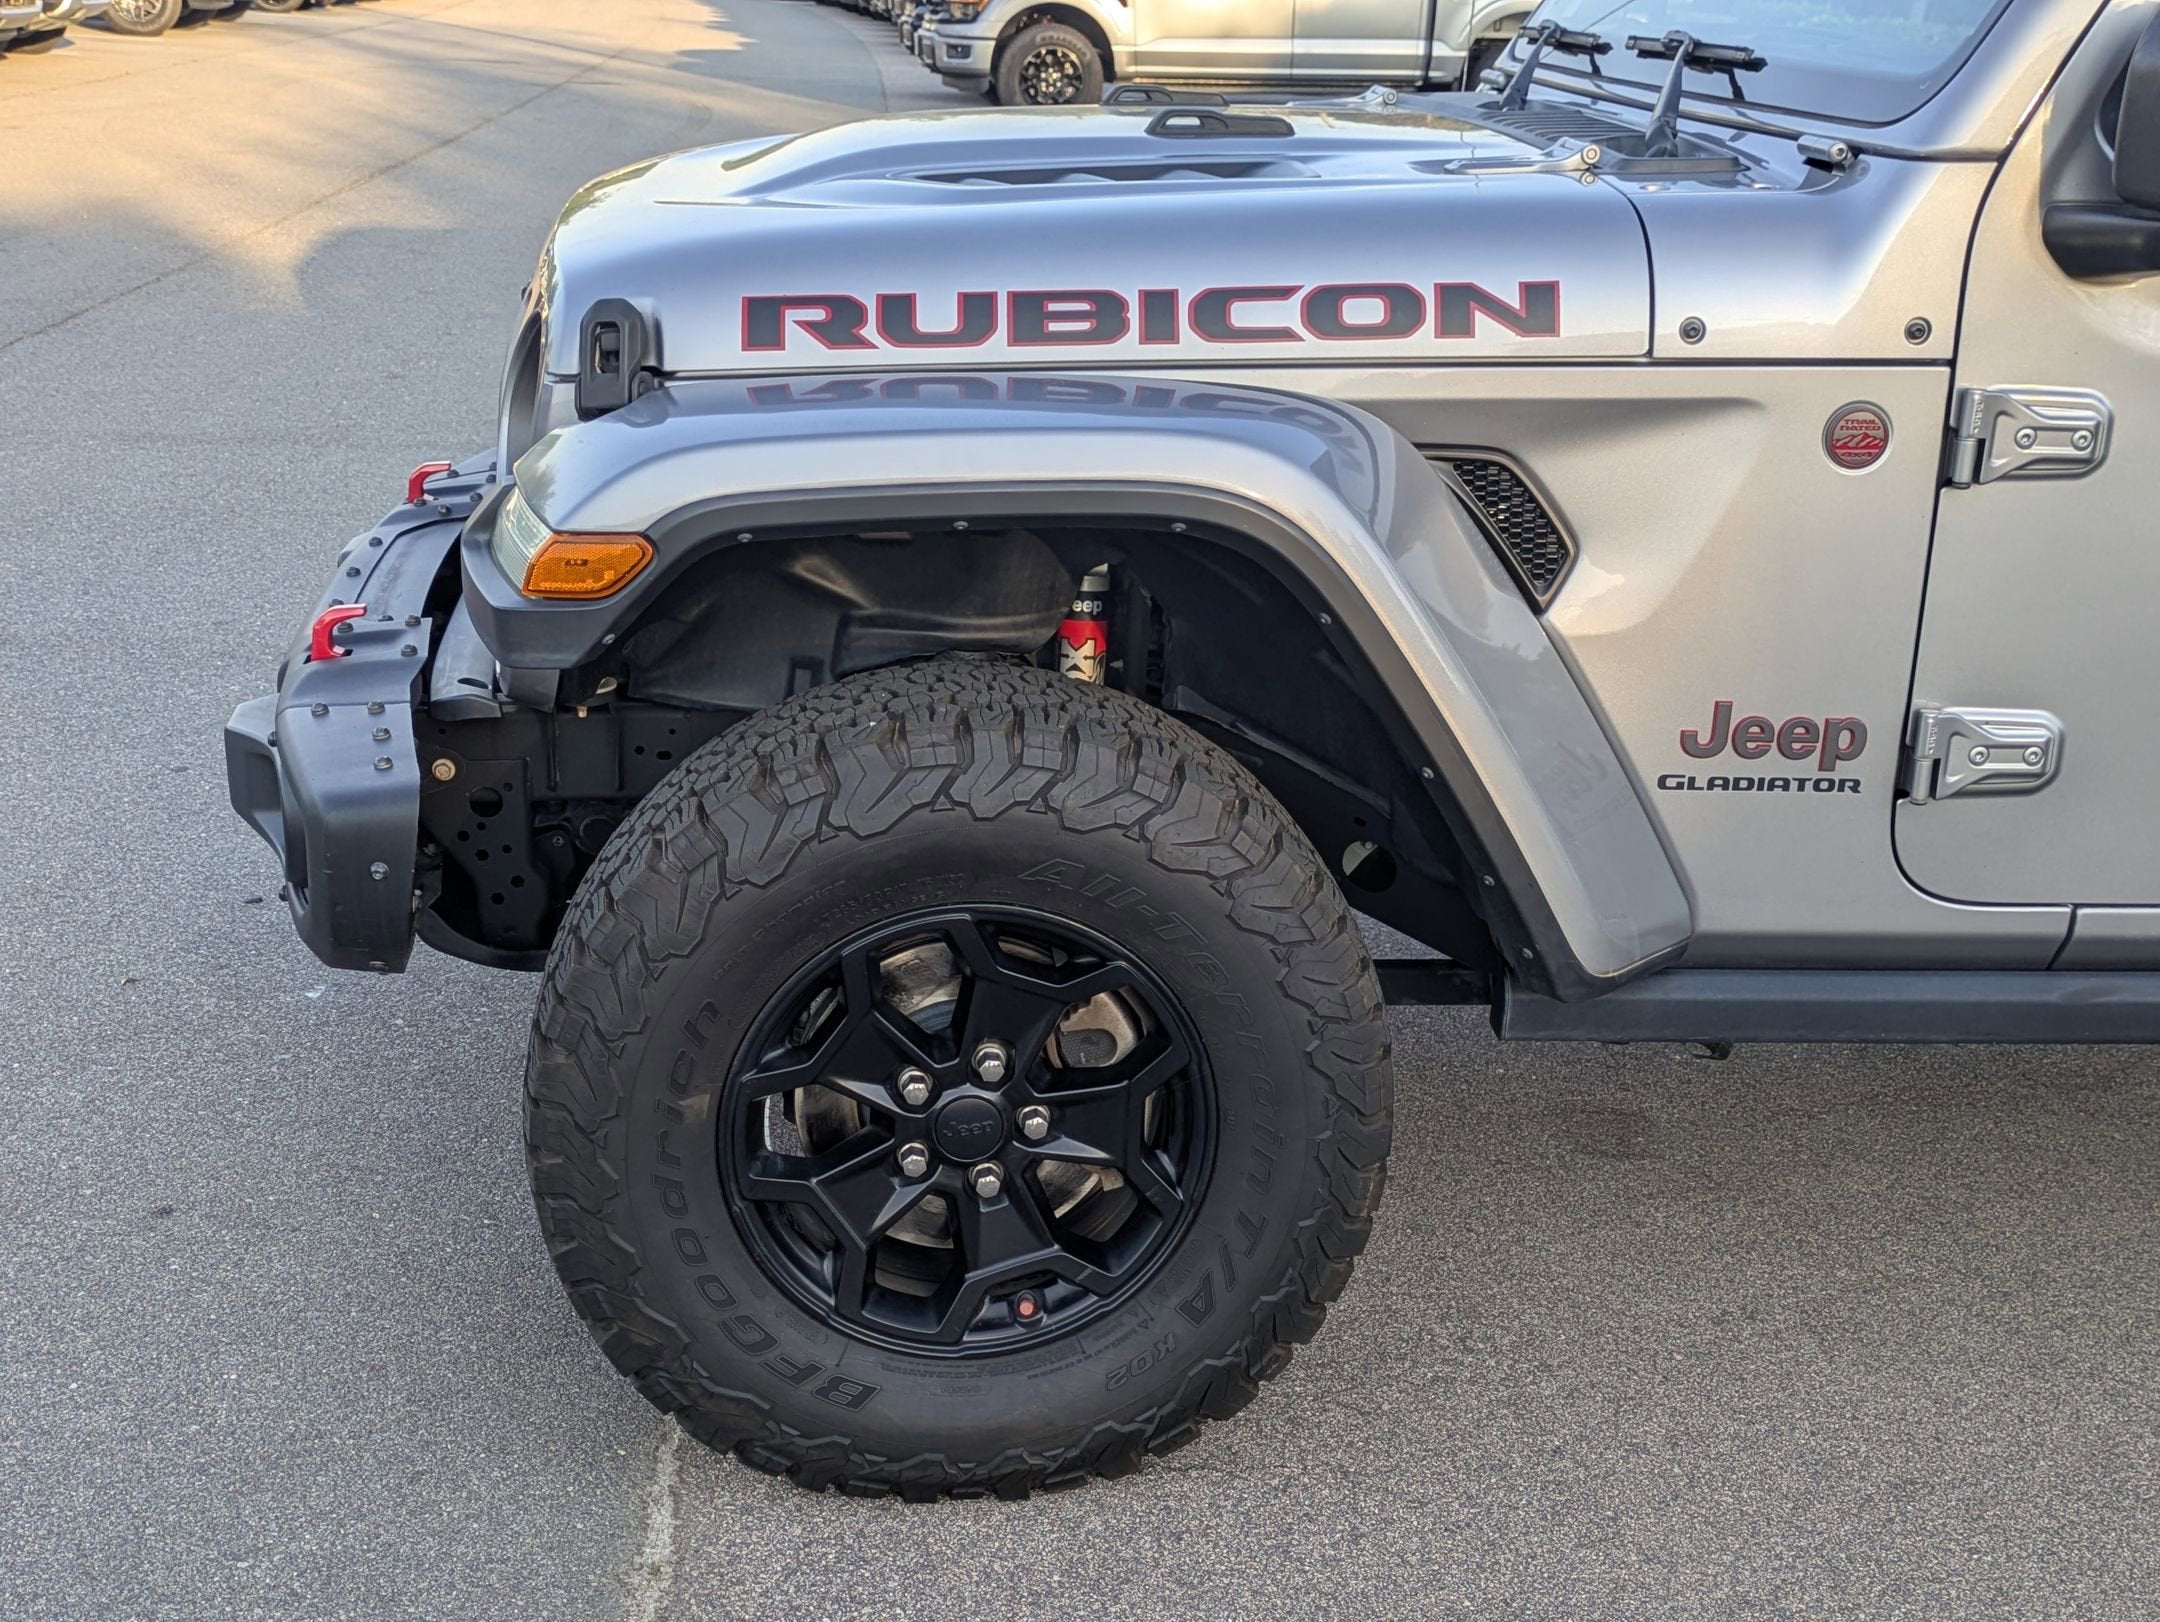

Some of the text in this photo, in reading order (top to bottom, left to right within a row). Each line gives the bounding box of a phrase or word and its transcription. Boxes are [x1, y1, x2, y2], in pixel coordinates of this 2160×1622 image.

[741, 280, 1560, 352] RUBICON
[1680, 700, 1868, 771] Jeep
[1656, 774, 1862, 794] GLADIATOR
[651, 1000, 881, 1412] BFGoodrich
